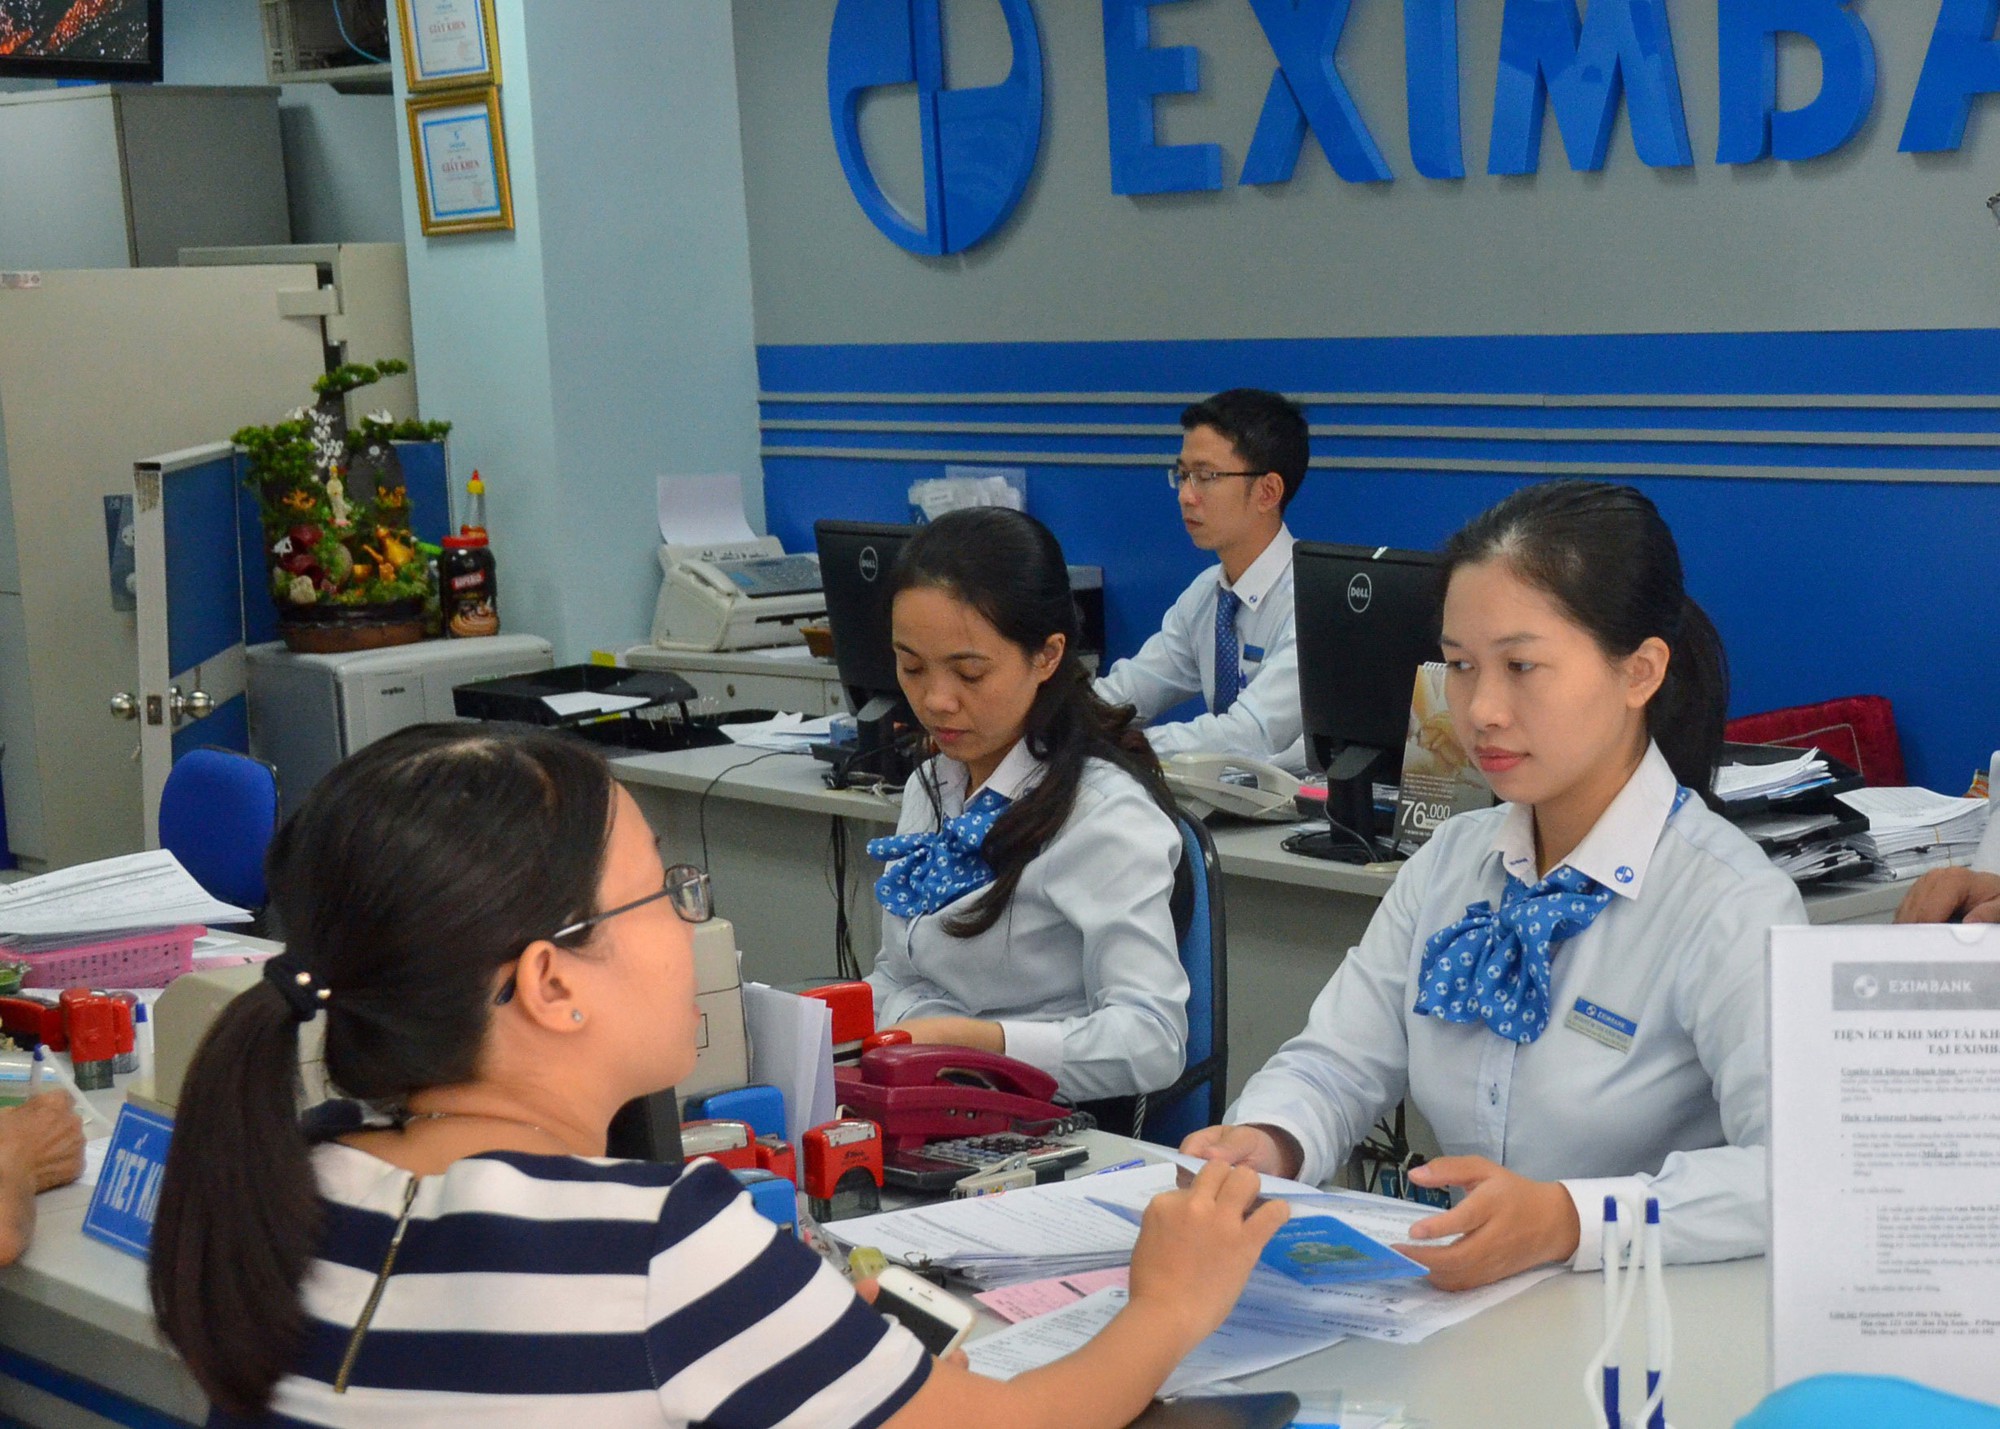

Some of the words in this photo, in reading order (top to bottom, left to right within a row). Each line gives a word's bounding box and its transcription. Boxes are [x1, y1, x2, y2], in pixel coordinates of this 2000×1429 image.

[1350, 586, 1369, 598] DELL
[1401, 800, 1450, 829] 76.000
[1888, 979, 1973, 993] EXIMBANK
[1896, 1029, 1922, 1040] KHI
[1979, 1028, 2000, 1040] KH
[1953, 1043, 2000, 1054] EXIMB
